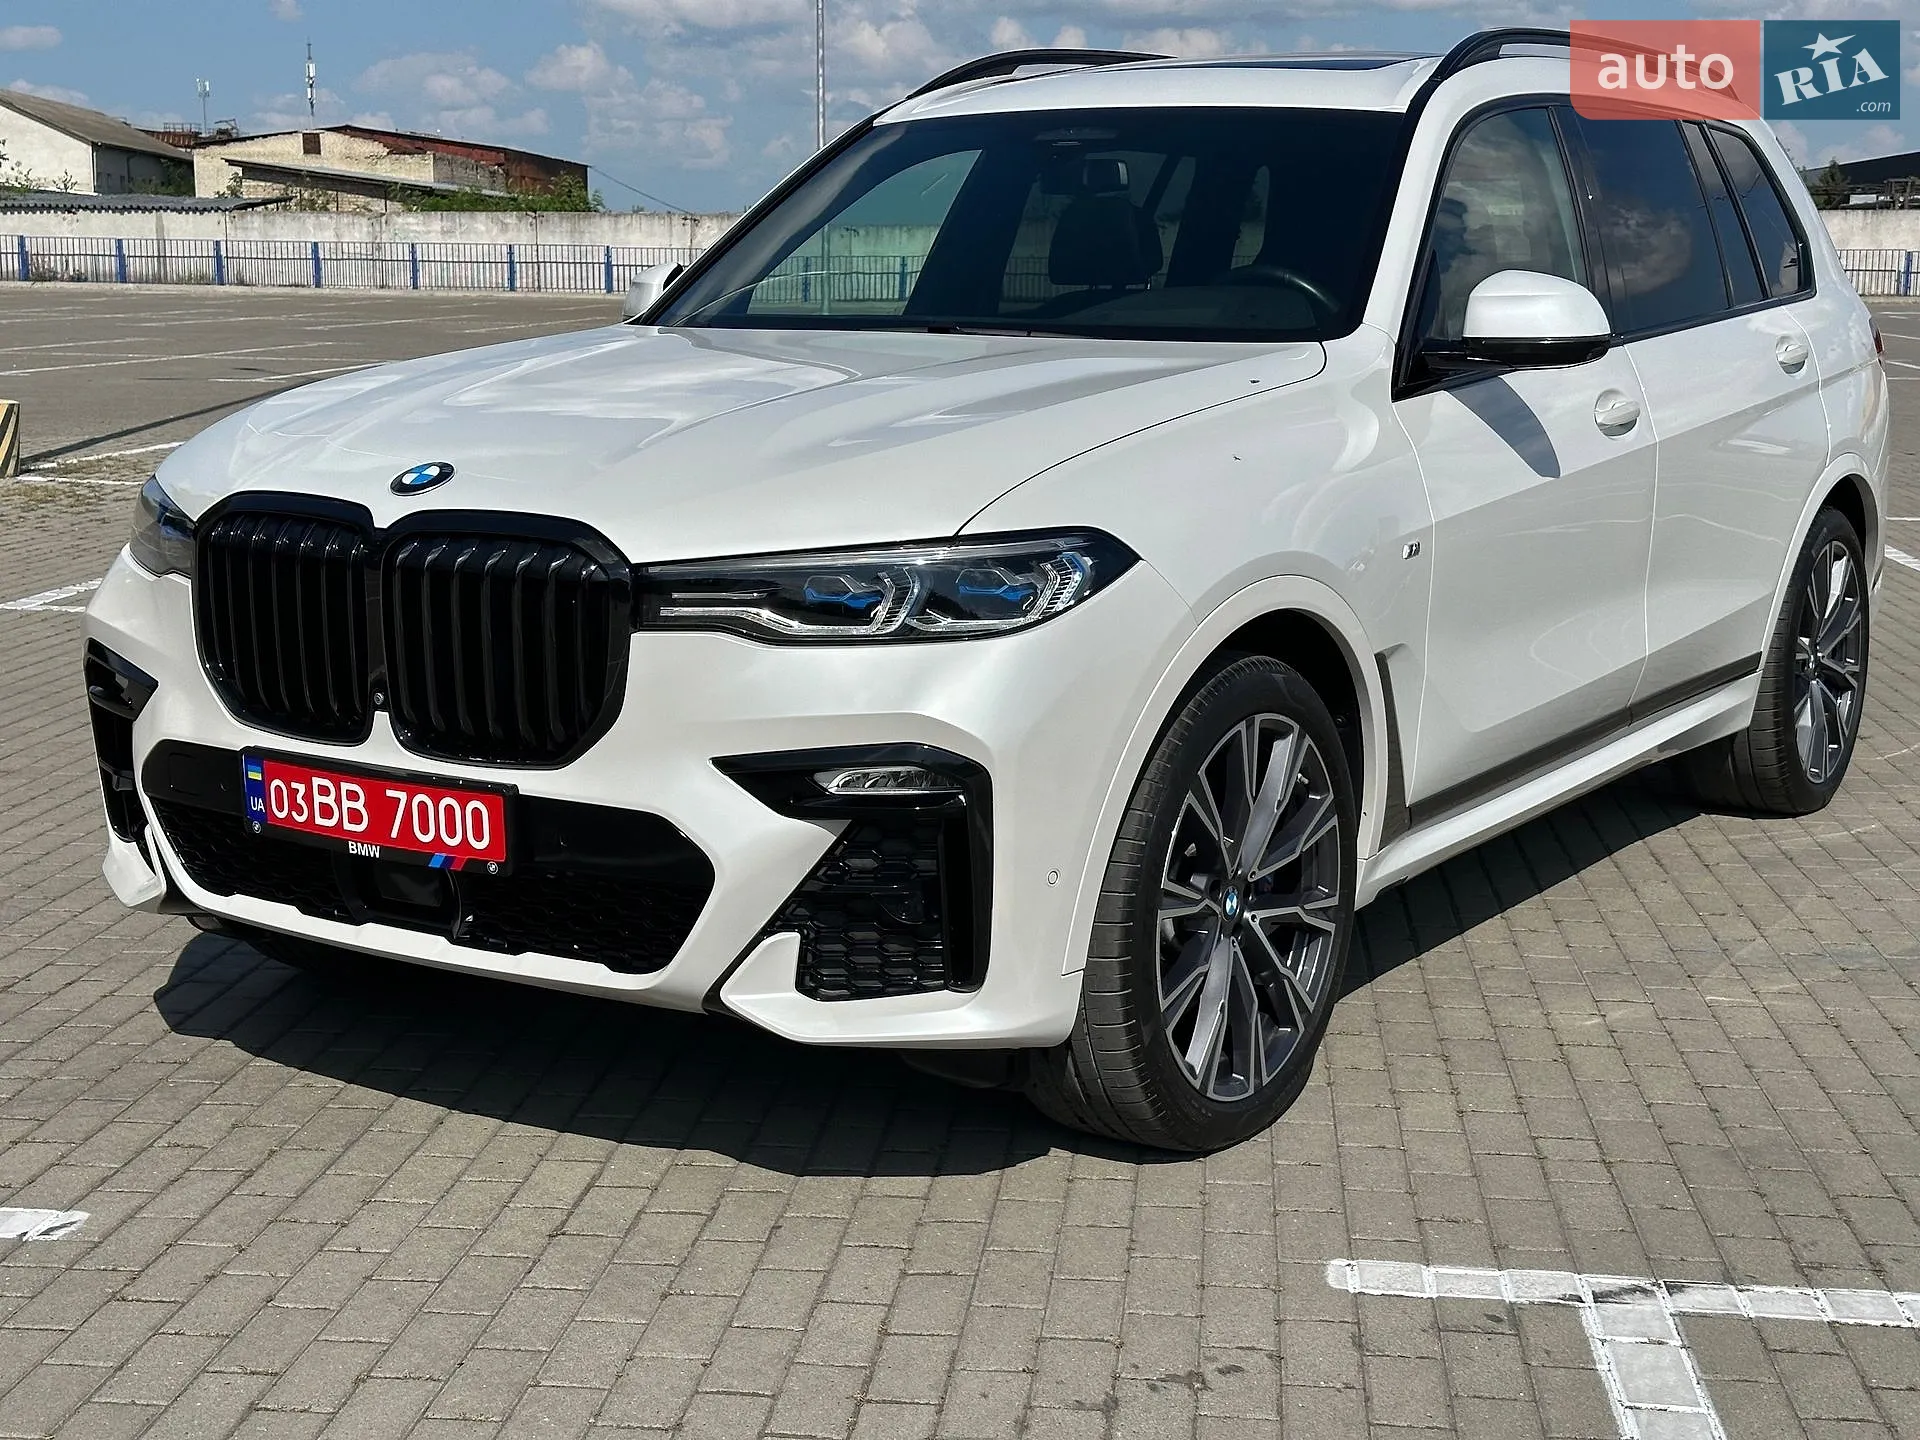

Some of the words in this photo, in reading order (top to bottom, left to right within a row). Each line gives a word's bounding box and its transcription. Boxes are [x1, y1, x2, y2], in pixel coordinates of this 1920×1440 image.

[250, 796, 265, 813] UA
[270, 776, 369, 833] 03BB
[385, 789, 490, 850] 7000
[348, 841, 380, 858] BMW
